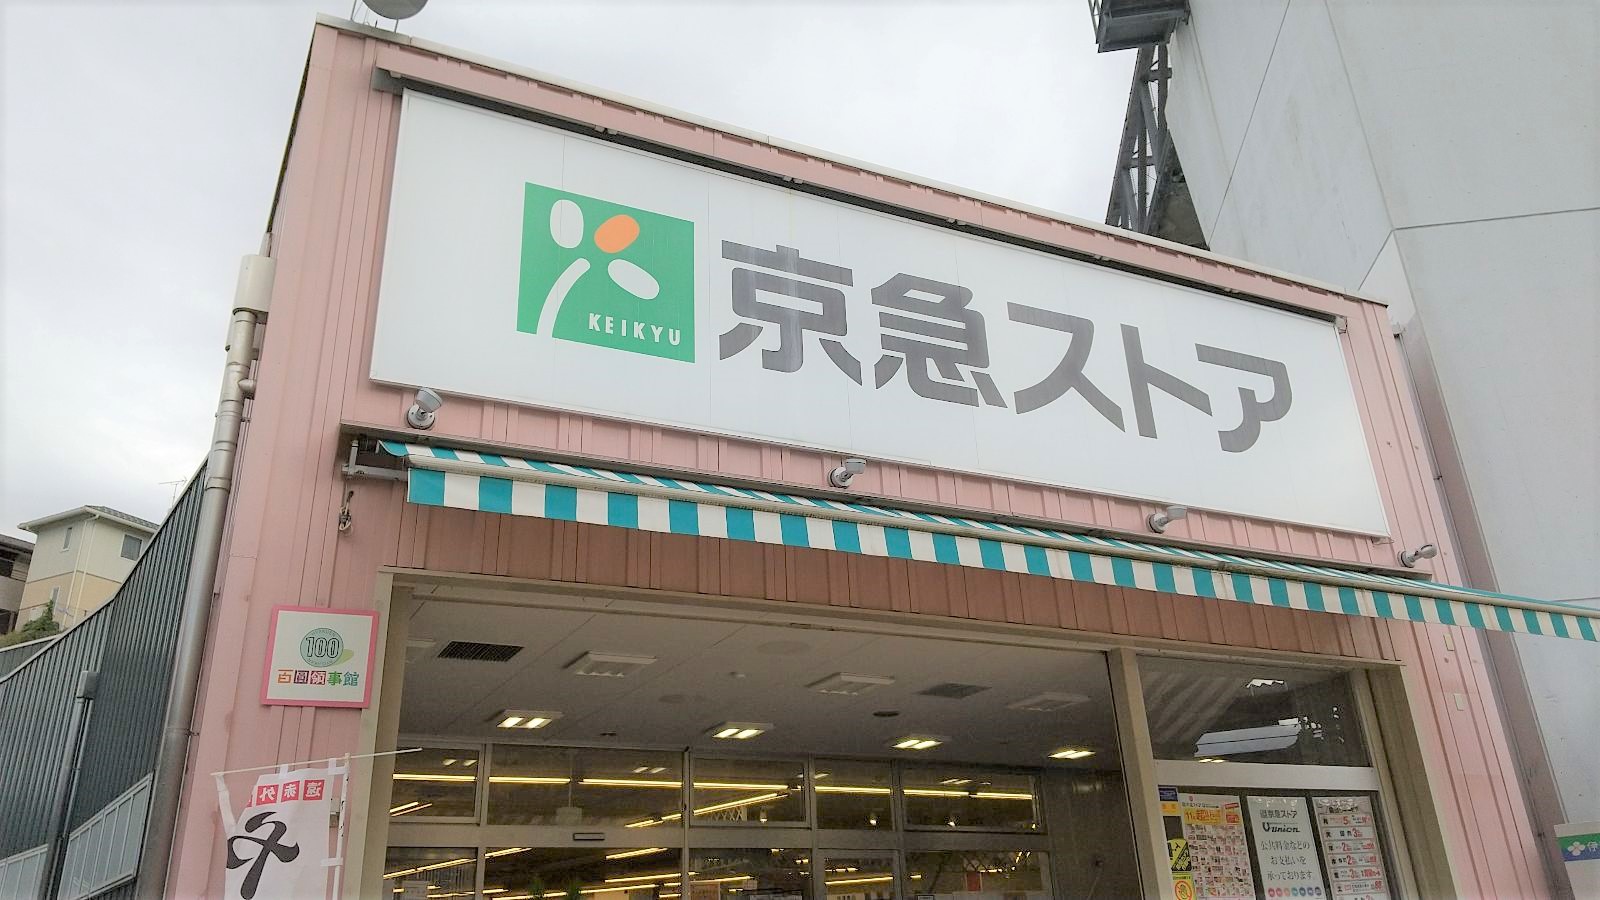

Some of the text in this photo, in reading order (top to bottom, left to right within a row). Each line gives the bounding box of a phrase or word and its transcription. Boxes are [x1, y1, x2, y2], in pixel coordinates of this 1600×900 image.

[588, 312, 681, 346] KEIKYU
[719, 239, 1293, 453] 京急ストア
[306, 636, 340, 658] 100
[277, 669, 360, 686] 百圓領事館
[1261, 840, 1310, 851] 公共料金などの
[1270, 855, 1307, 865] お支払いを
[1267, 870, 1313, 881] 承っております
